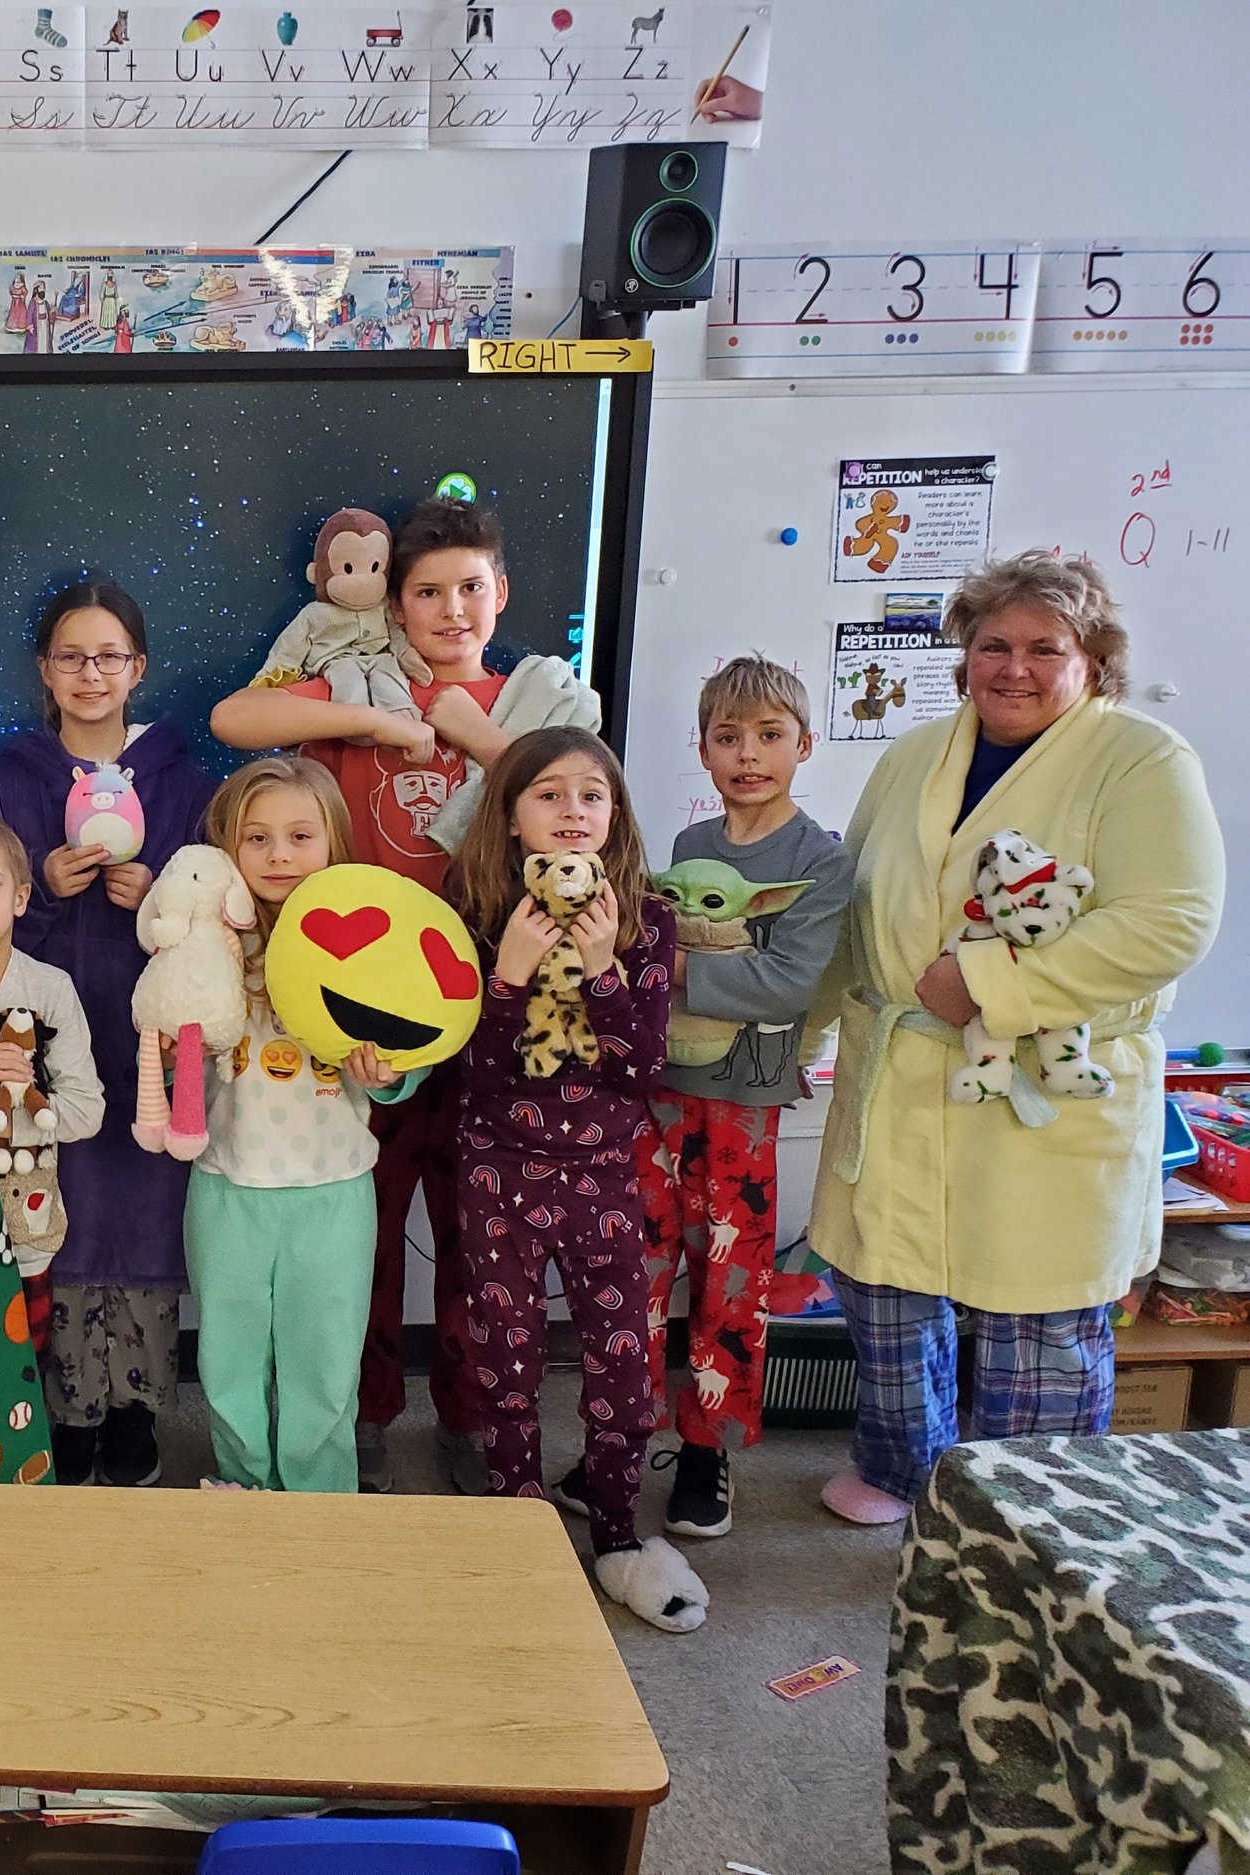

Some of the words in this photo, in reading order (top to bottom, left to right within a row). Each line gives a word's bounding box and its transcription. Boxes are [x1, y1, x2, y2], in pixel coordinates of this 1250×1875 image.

[15, 250, 47, 258] SAMUEL
[66, 255, 111, 263] CHRONICLES
[732, 258, 740, 324] 1
[795, 257, 831, 323] 2
[887, 255, 926, 321] 3
[978, 253, 1020, 320] 4
[1084, 251, 1125, 319] 5
[1182, 250, 1222, 318] 6
[480, 342, 577, 372] RIGHT
[1121, 512, 1157, 568] Q
[1186, 527, 1230, 556] 1-11
[840, 633, 931, 649] REPETITION
[843, 624, 862, 635] Why
[864, 624, 875, 632] do
